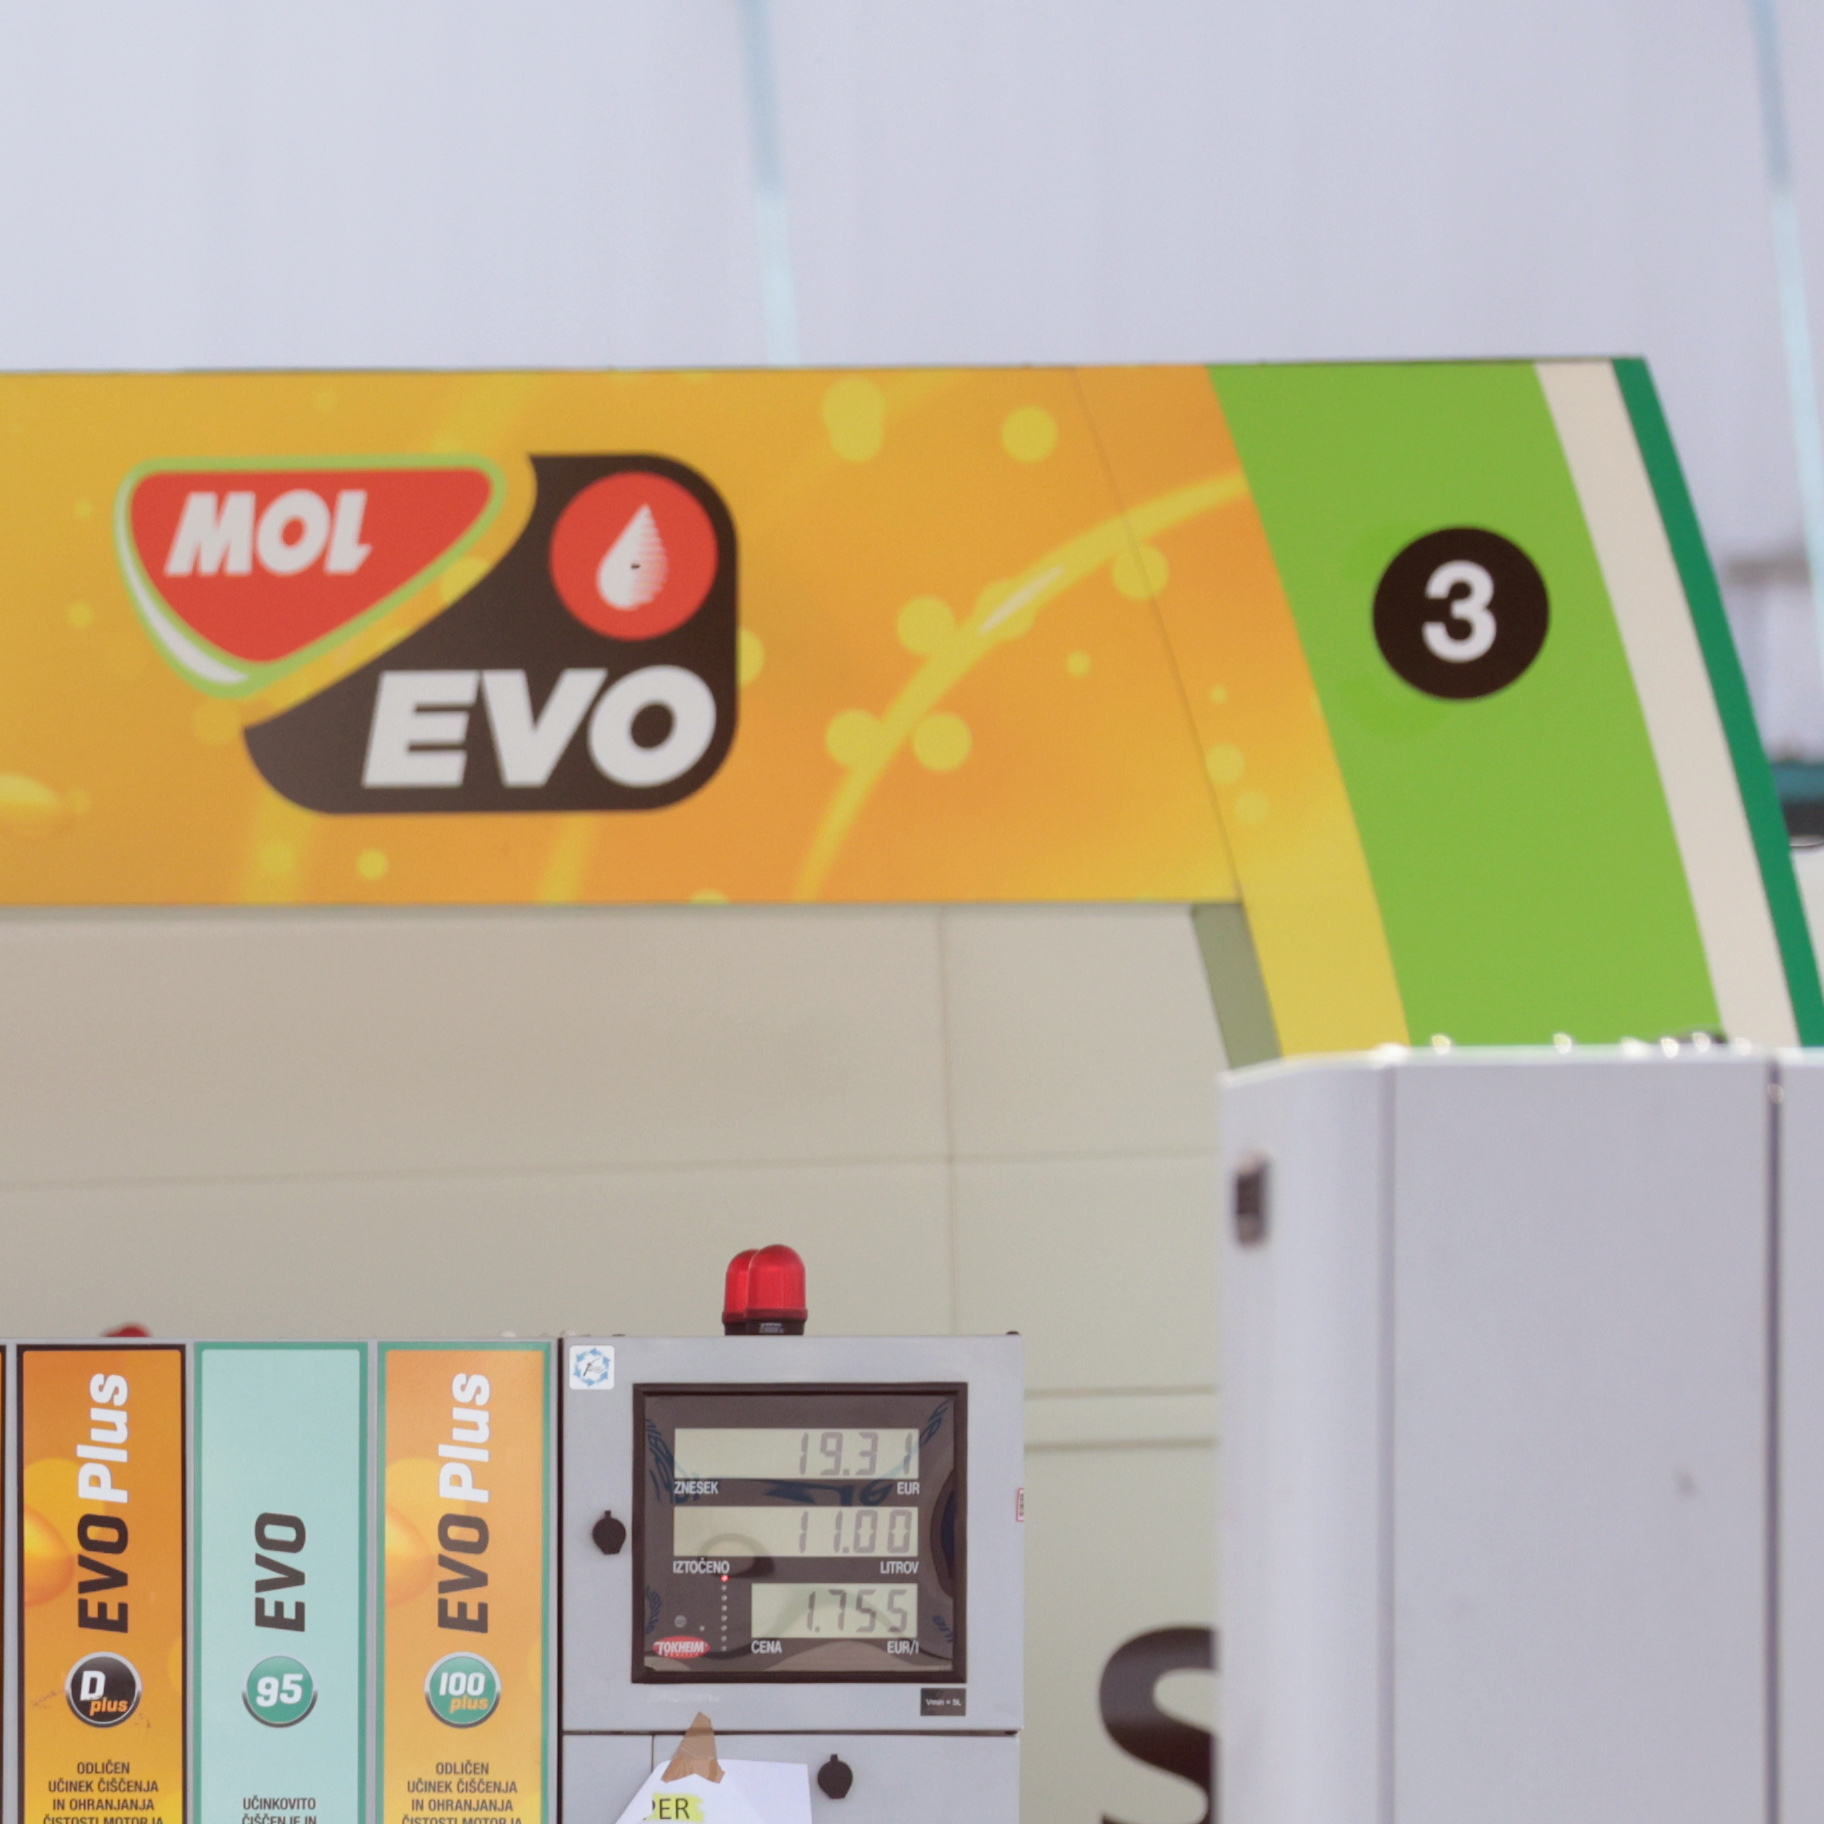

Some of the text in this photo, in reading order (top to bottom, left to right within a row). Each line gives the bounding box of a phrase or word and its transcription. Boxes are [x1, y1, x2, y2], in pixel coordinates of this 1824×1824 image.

[164, 489, 373, 576] MOL
[1420, 562, 1497, 664] 3
[361, 665, 716, 788] EVO
[798, 1431, 914, 1476] 19.31
[673, 1481, 719, 1495] ZNESEK
[896, 1482, 920, 1496] EUR
[77, 1372, 129, 1634] EVO Plus
[437, 1372, 491, 1634] EVO Plus
[798, 1509, 914, 1554] 11.00
[254, 1512, 306, 1633] EVO
[672, 1557, 730, 1575] IZTOČENO
[880, 1561, 920, 1575] LITROV
[805, 1589, 909, 1633] 1.755
[653, 1640, 707, 1655] TOKHEIM
[751, 1640, 783, 1654] CENA
[80, 1670, 129, 1716] D plus
[256, 1673, 303, 1707] 95
[439, 1671, 489, 1713] 100 plus
[76, 1758, 130, 1775] ODLIČEN
[435, 1759, 490, 1776] ODLIČEN
[47, 1777, 159, 1793] UČINEK ČIŠČENJA
[407, 1777, 518, 1794] UČINEK ČIŠČENJA
[52, 1798, 155, 1811] IN OHRANJANJA
[242, 1794, 317, 1811] UČINKOVITO
[411, 1798, 514, 1812] IN OHRANJANJA
